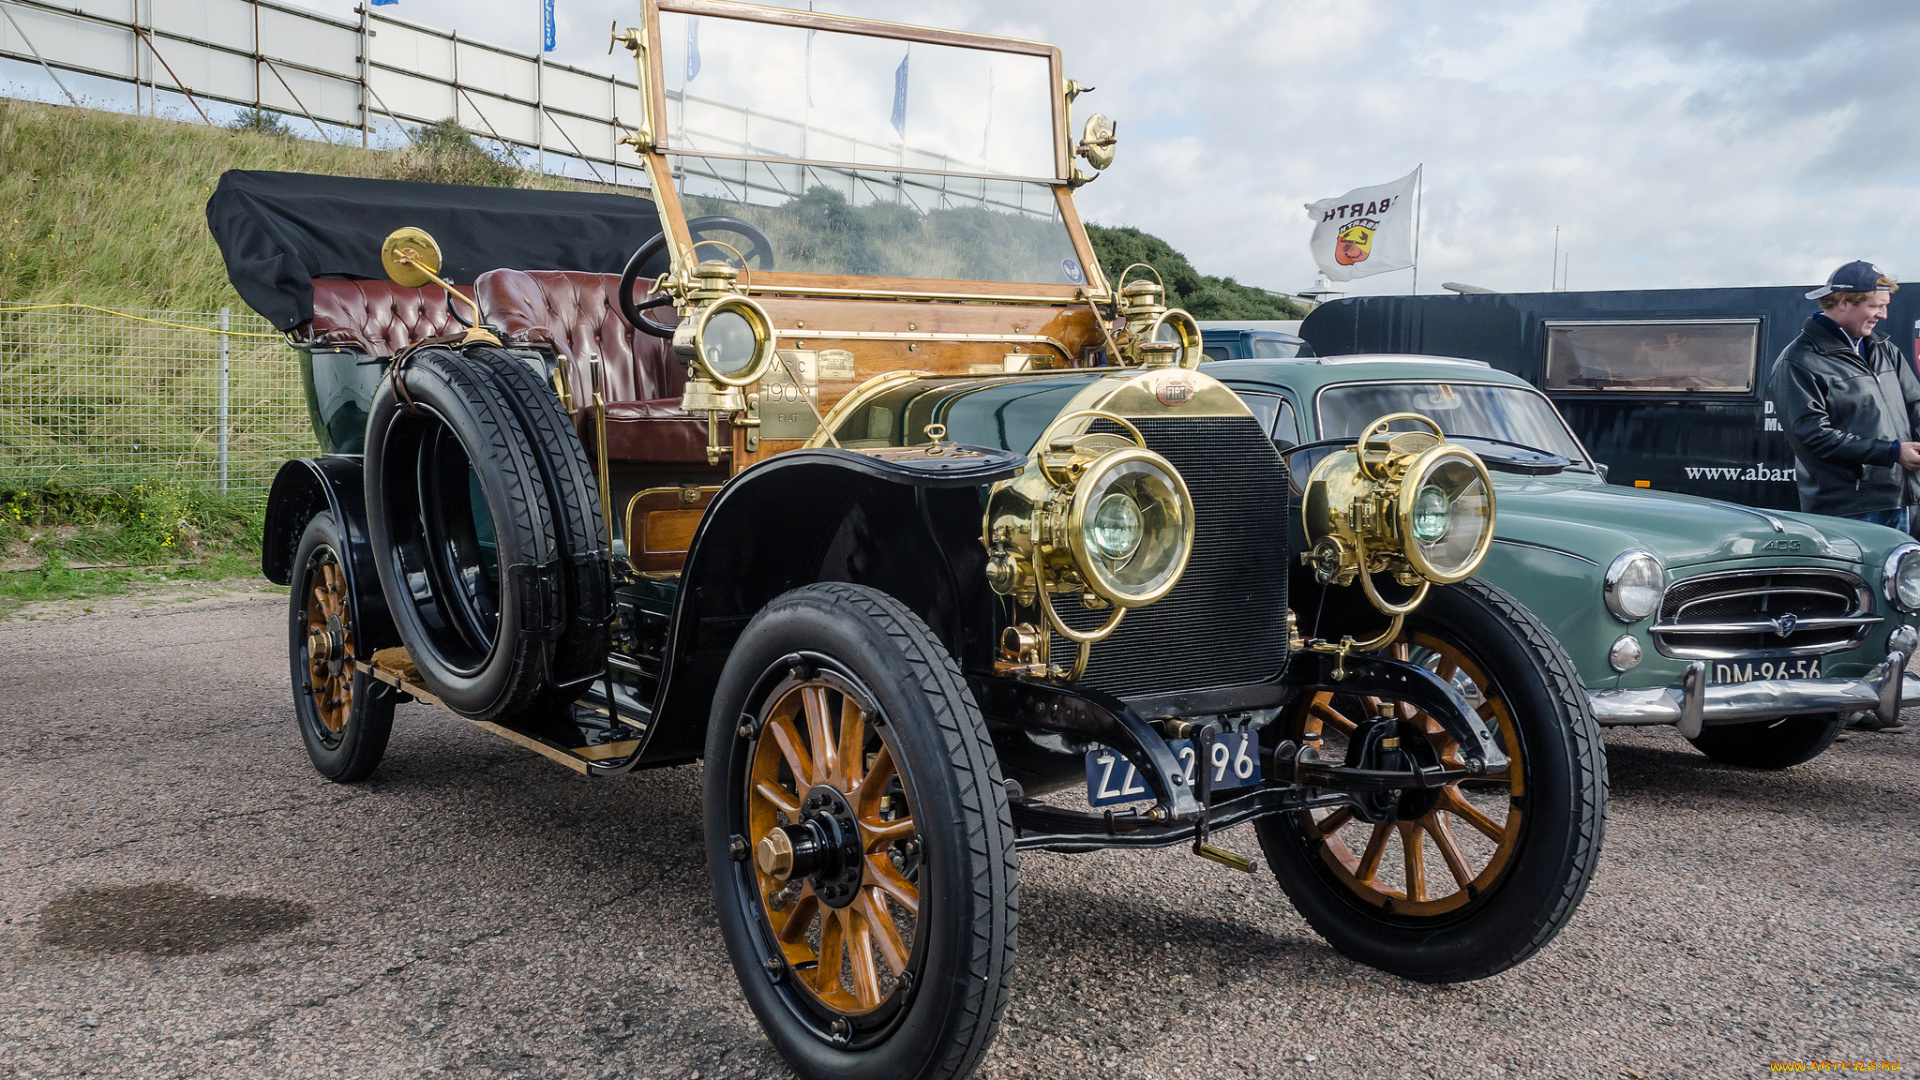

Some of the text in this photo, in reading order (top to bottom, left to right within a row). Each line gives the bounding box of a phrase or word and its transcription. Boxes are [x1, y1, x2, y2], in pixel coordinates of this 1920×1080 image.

[1165, 385, 1186, 400] FIAT
[778, 414, 799, 423] FIAT
[1762, 540, 1801, 552] 403
[1716, 659, 1821, 684] DM-96-56
